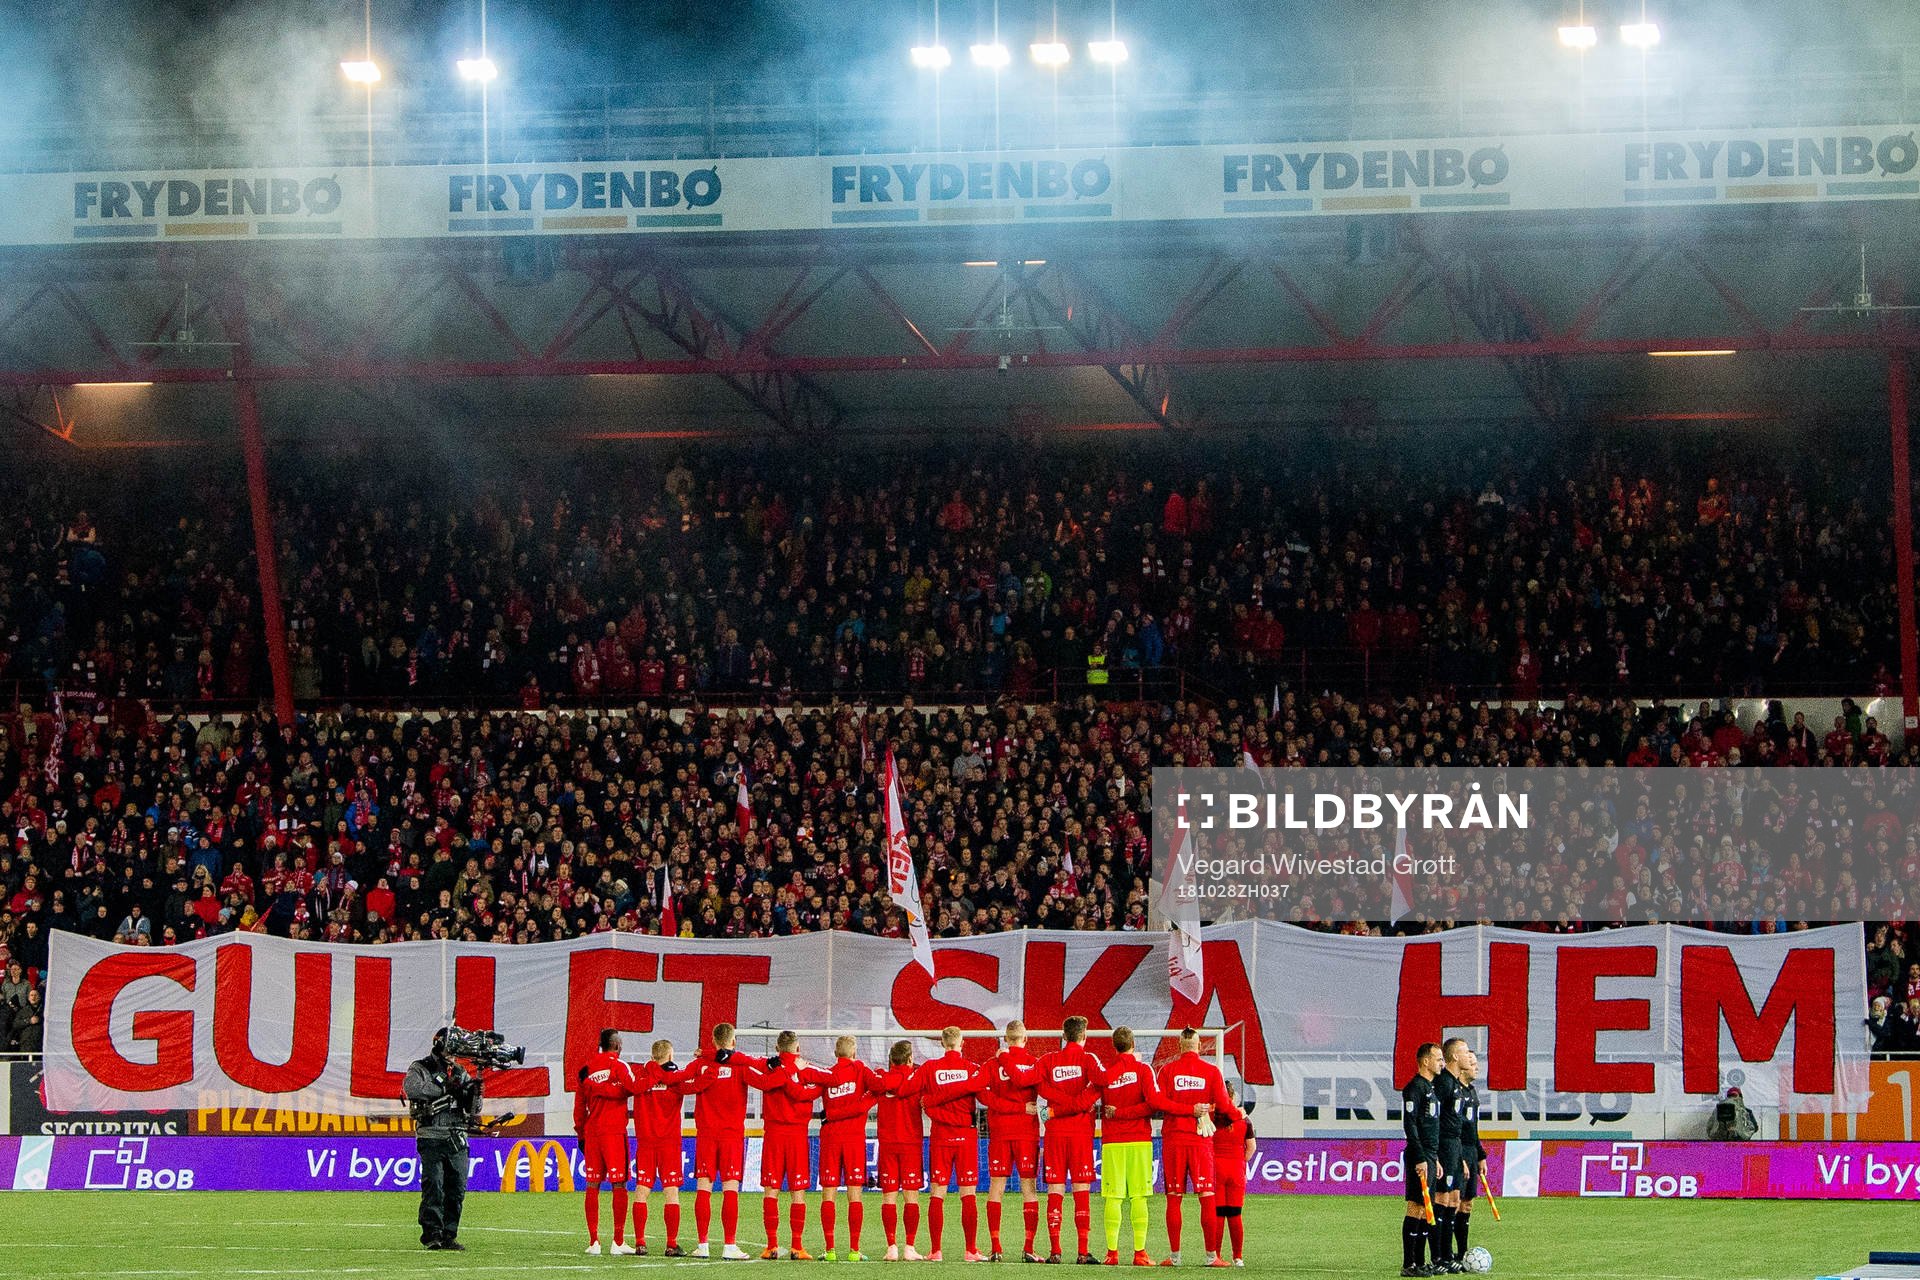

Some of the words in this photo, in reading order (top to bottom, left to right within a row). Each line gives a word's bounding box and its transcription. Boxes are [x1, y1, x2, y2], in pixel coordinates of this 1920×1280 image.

[1223, 144, 1510, 192] FRYDENBØ
[1624, 129, 1919, 182] FRYDENBØ
[73, 173, 343, 219] FRYDENBØ
[448, 164, 723, 212] FRYDENBØ
[831, 156, 1112, 203] FRYDENBØ
[70, 943, 771, 1099] GULLET
[889, 940, 1275, 1088] SKA
[1392, 941, 1836, 1096] HEM
[136, 1169, 194, 1189] BOB
[307, 1149, 335, 1178] Vi
[1635, 1175, 1698, 1197] BOB
[1817, 1154, 1850, 1185] Vi
